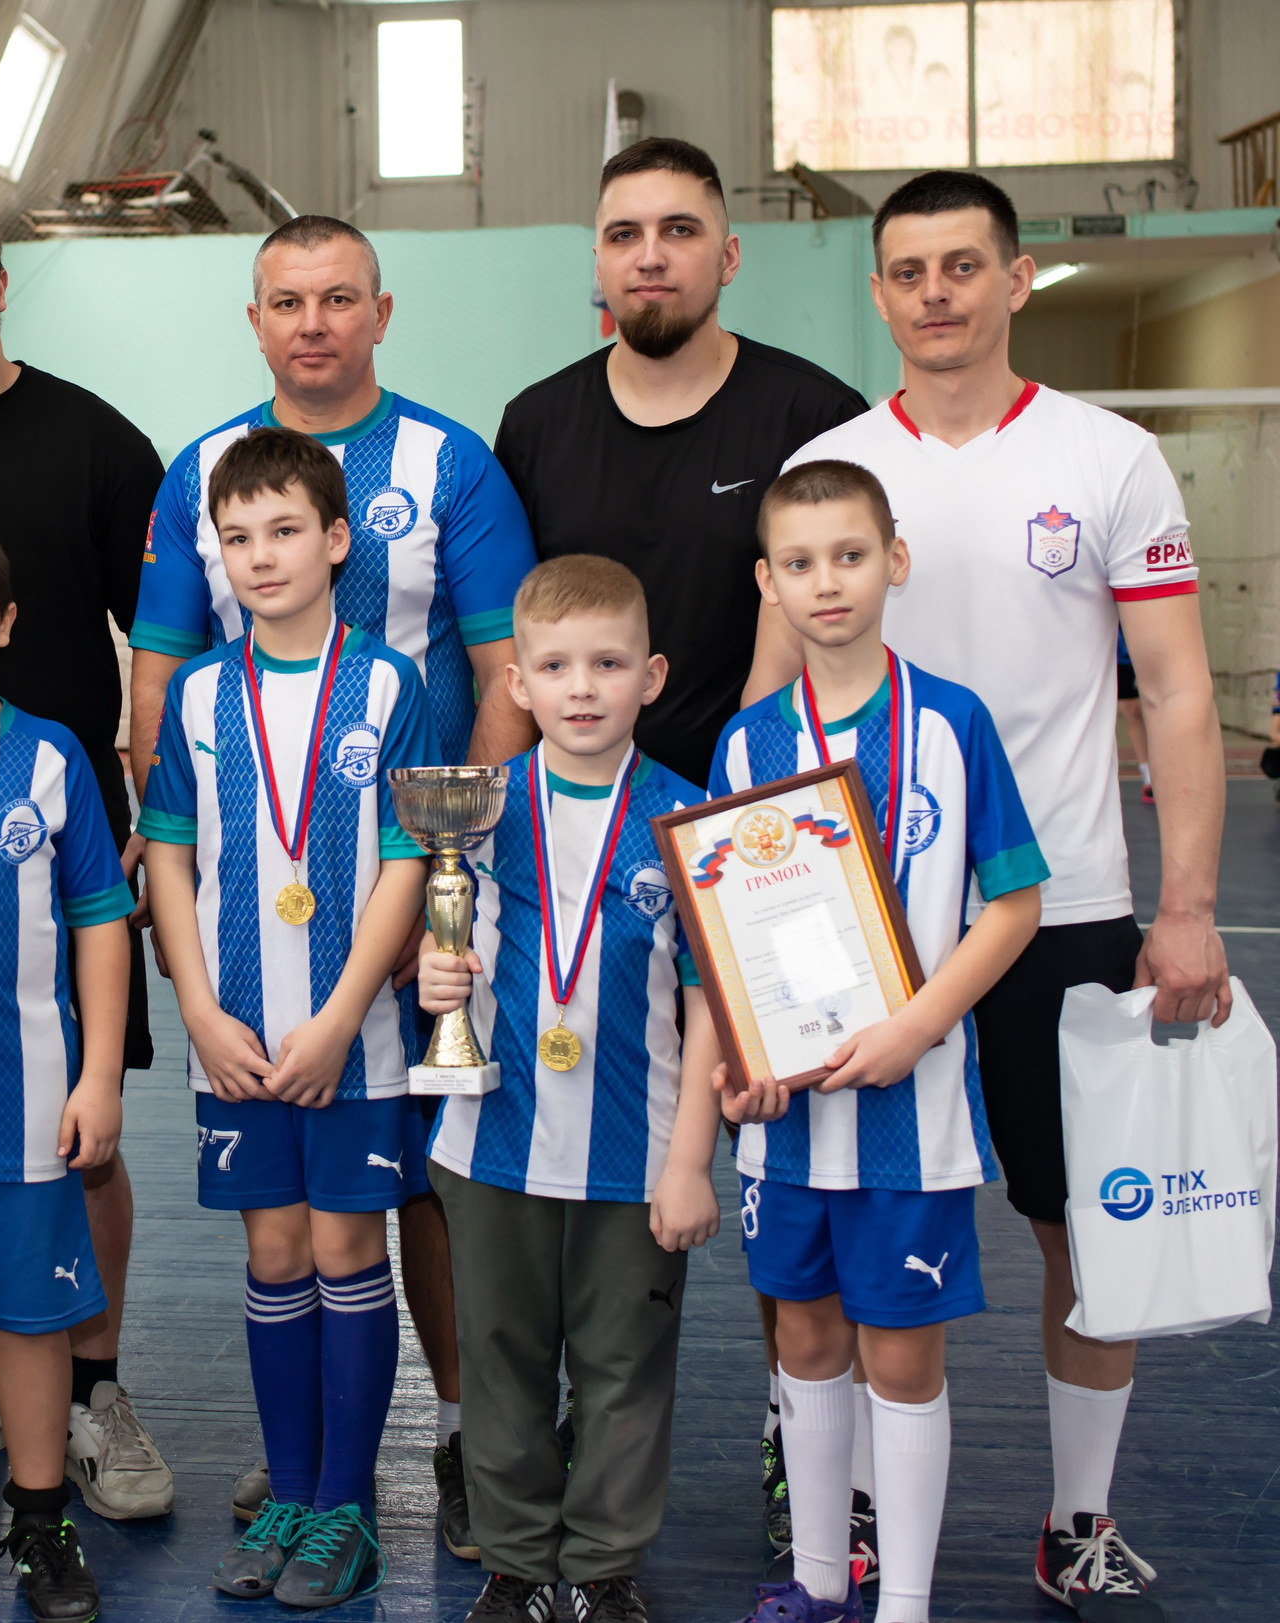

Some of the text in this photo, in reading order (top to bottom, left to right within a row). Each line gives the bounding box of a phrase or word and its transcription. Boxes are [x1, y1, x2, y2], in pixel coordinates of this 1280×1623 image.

[1146, 540, 1193, 565] ВРАЧ
[339, 723, 376, 738] СТАНИЦА
[745, 862, 812, 892] ГРАМОТА
[798, 1019, 822, 1035] 2025
